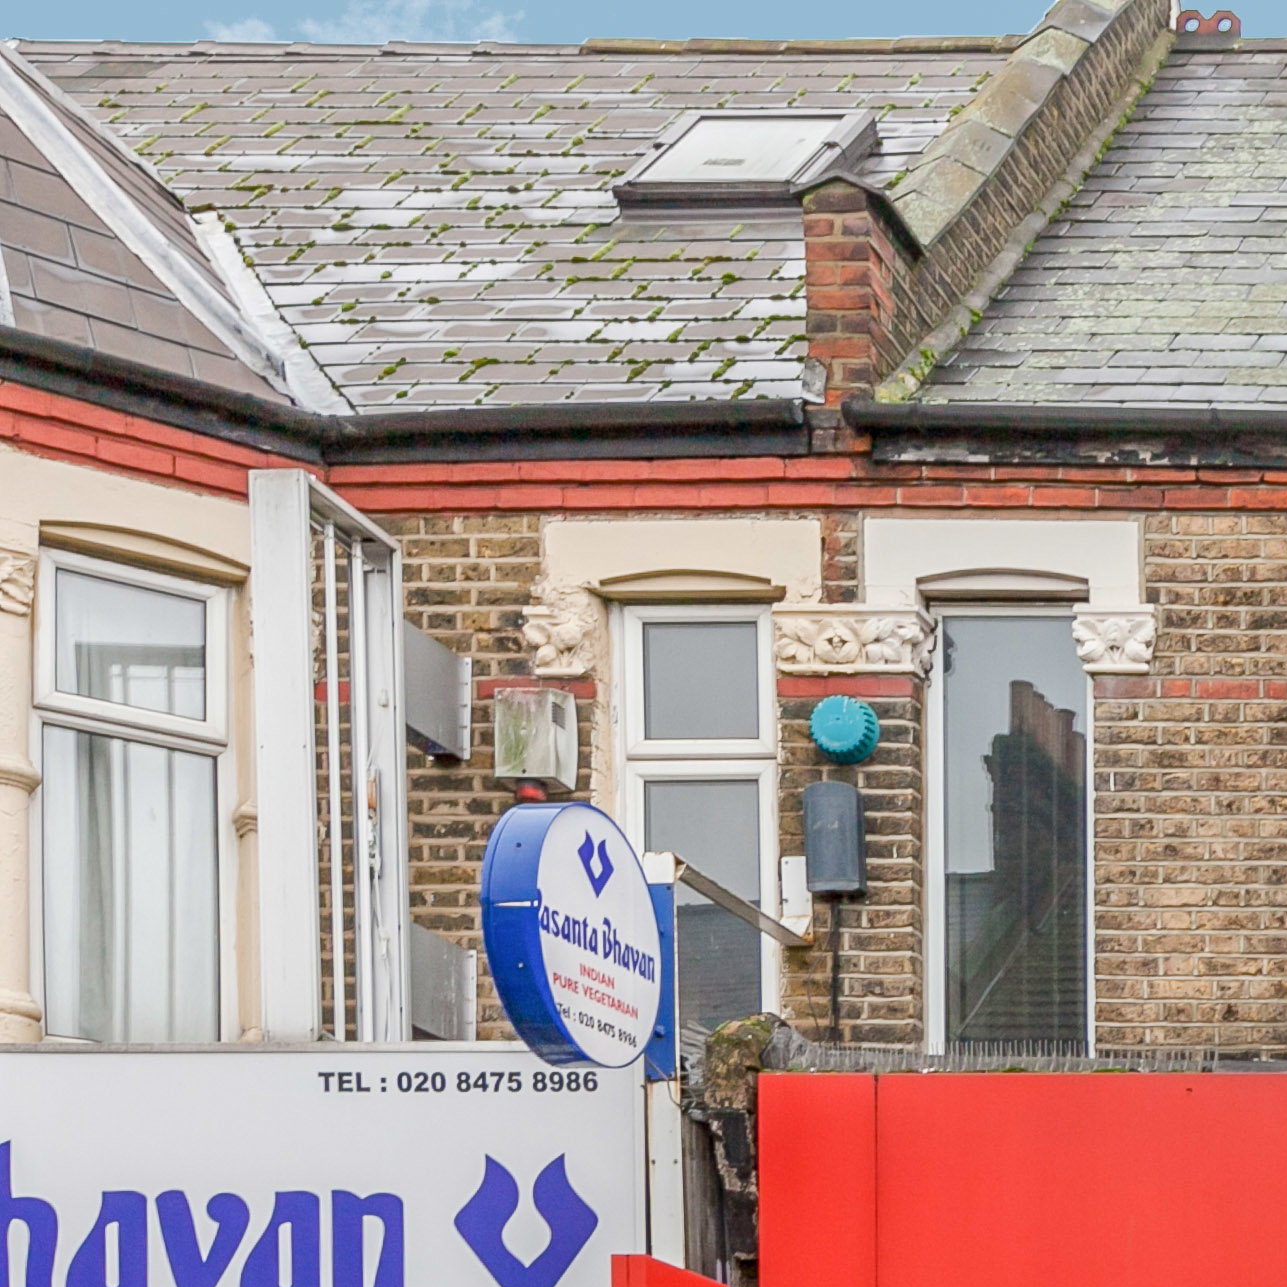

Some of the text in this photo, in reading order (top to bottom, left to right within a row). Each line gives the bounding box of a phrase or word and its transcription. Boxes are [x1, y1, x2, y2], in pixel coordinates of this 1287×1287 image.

[603, 917, 655, 983] Bhavan
[579, 963, 615, 990] INDIAN
[553, 972, 639, 1020] PURE VEGETARIAN
[578, 1011, 595, 1029] 020
[597, 1021, 616, 1038] 8475
[618, 1028, 637, 1048] 8986
[319, 1072, 371, 1093] TEL
[397, 1072, 446, 1093] 020
[456, 1072, 522, 1093] 8475
[532, 1072, 599, 1093] 8986
